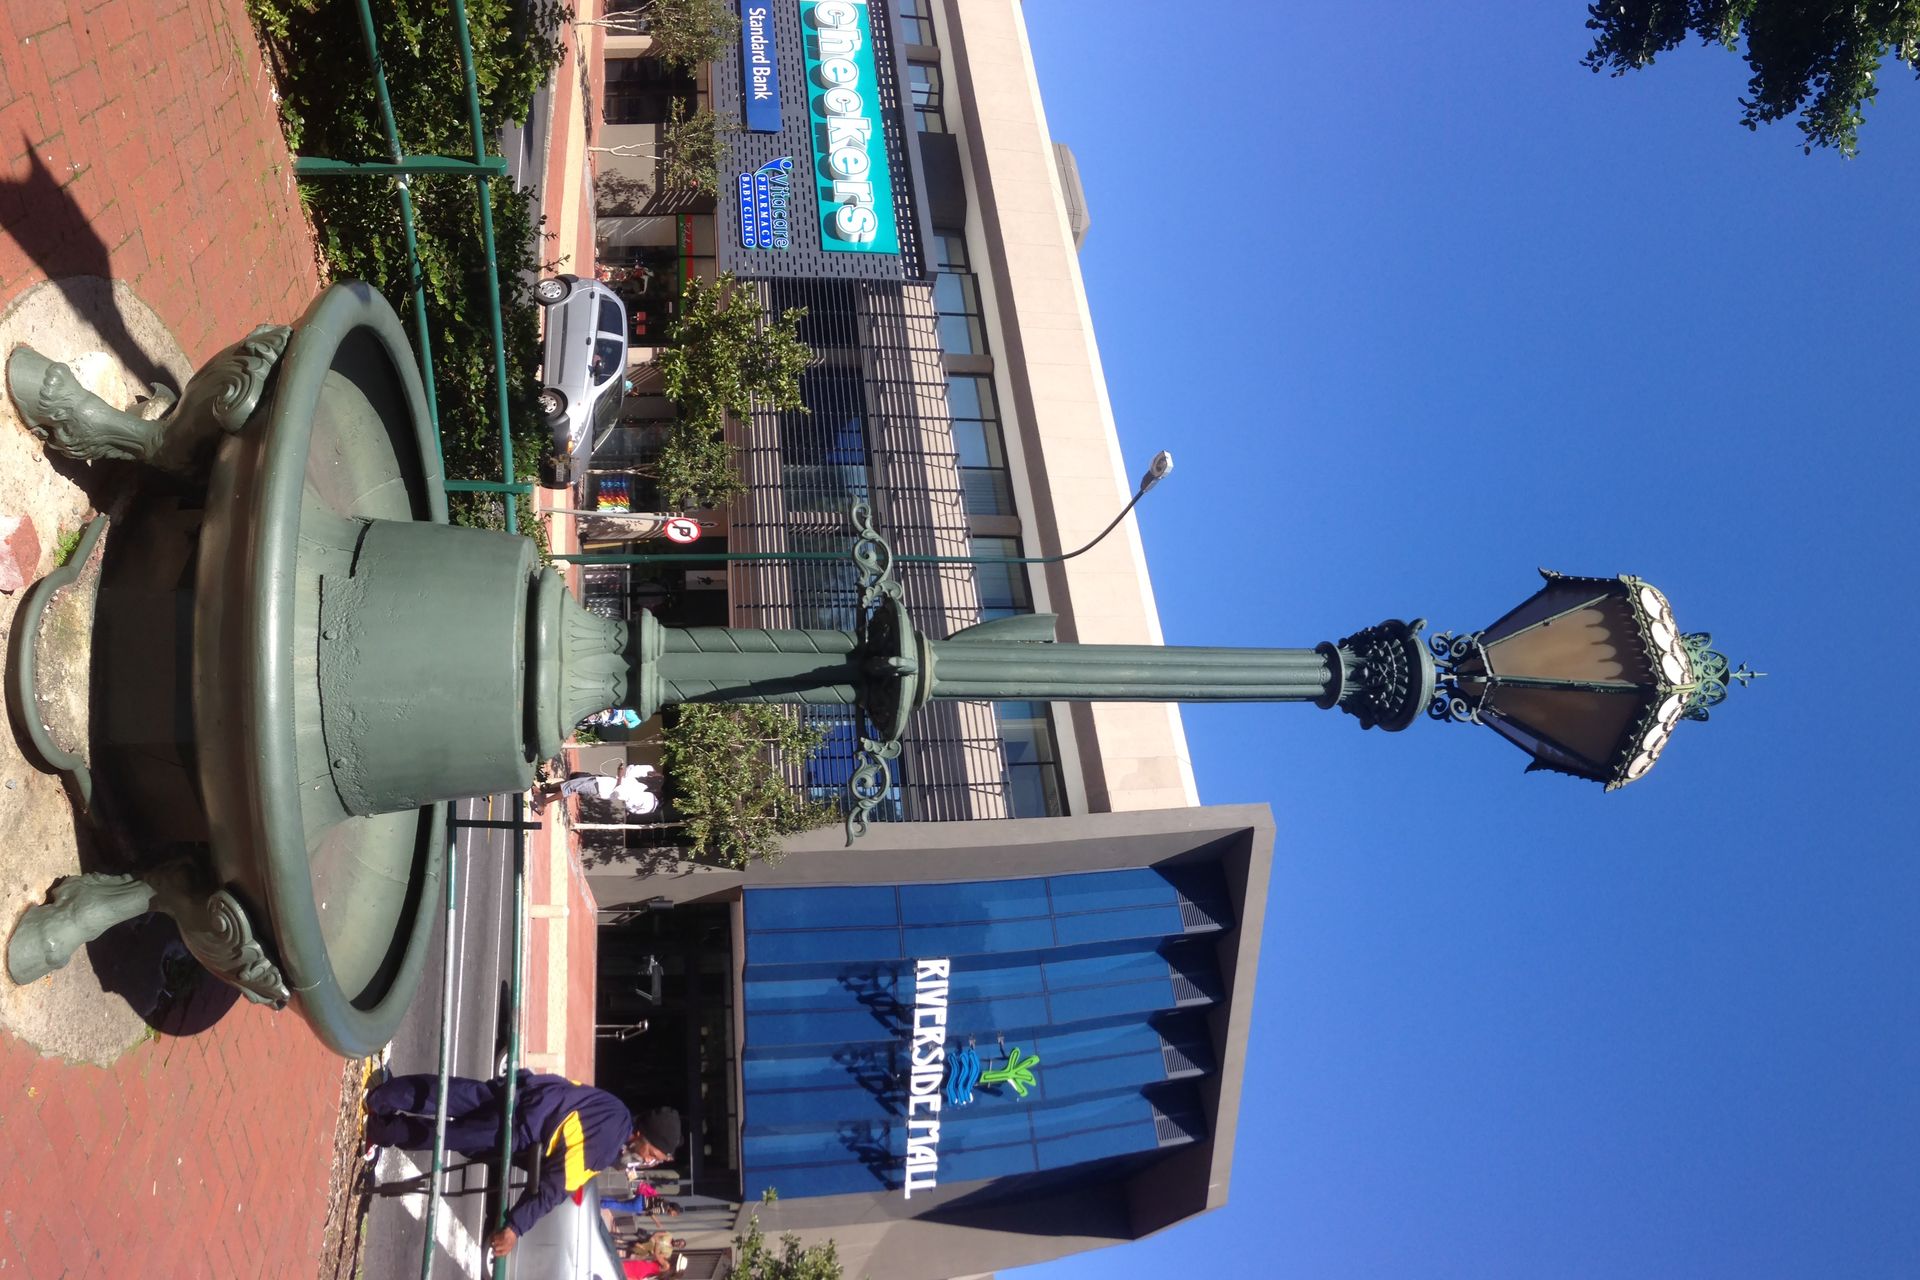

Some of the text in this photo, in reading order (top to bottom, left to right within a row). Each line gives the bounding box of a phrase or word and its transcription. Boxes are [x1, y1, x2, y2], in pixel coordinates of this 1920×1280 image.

[748, 7, 774, 101] Standard Bank
[814, 0, 878, 240] Checkers
[741, 176, 754, 245] BABY CLINIC
[758, 176, 770, 245] PHARMACY
[770, 174, 790, 249] Vitacare
[904, 958, 951, 1200] RIVERSIDE MALL
